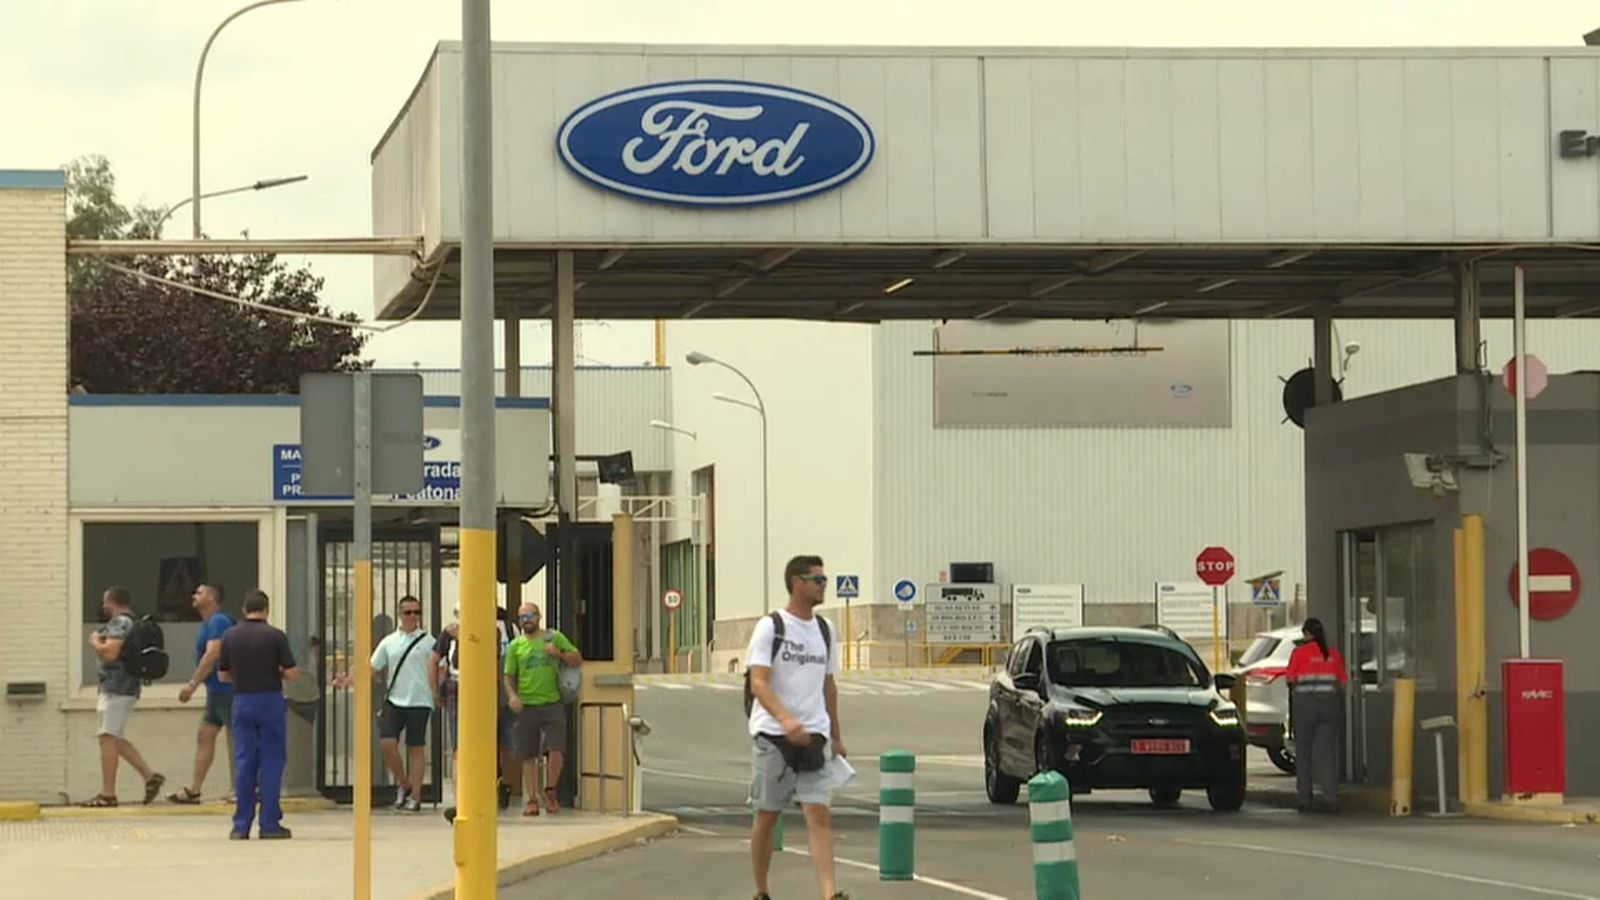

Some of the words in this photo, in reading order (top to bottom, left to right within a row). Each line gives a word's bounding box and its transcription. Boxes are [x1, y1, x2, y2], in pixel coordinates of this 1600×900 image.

[622, 100, 810, 177] Ford
[1197, 560, 1234, 572] STOP
[783, 640, 804, 652] The
